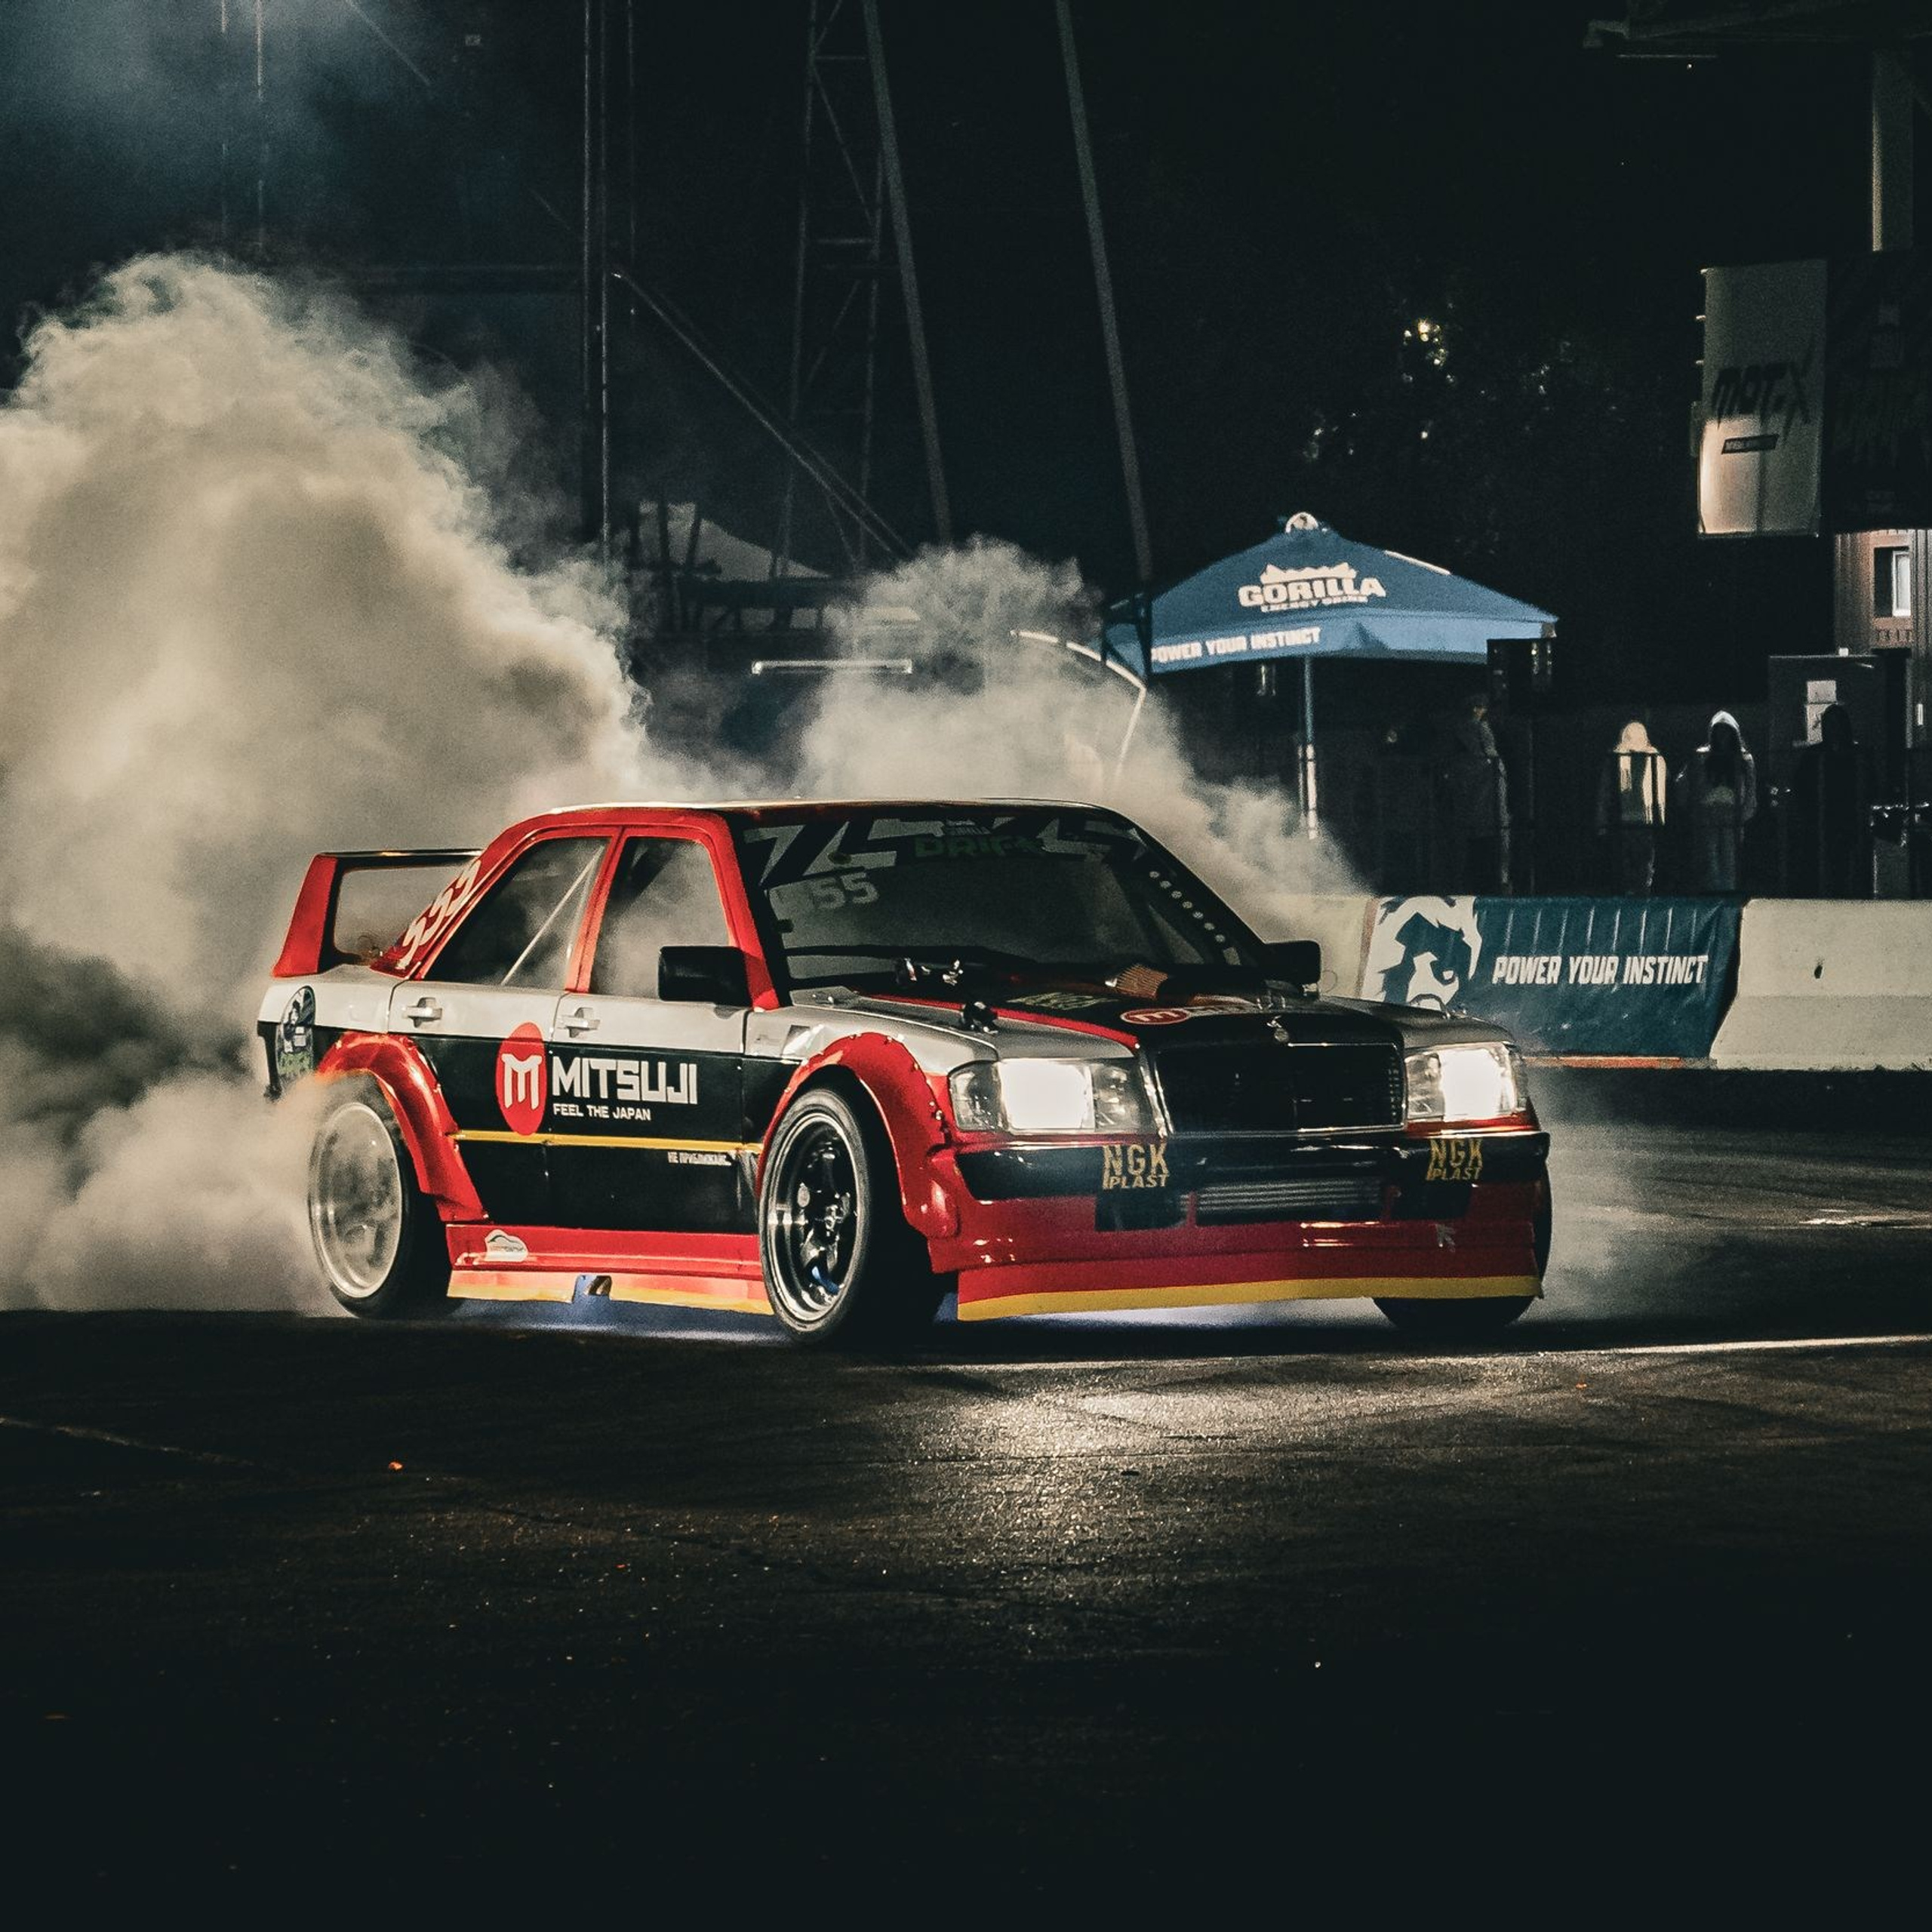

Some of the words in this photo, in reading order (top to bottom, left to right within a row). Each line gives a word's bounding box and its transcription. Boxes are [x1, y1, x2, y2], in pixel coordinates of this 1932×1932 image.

[1238, 577, 1386, 607] GORILLA
[1204, 635, 1247, 656] YOUR
[1250, 626, 1321, 650] INSTINCT
[1491, 955, 1561, 986] POWER
[1567, 955, 1620, 985] YOUR
[1623, 954, 1709, 985] INSTINCT
[552, 1056, 698, 1105] MITSUJI
[553, 1103, 584, 1117] FEEL
[586, 1105, 610, 1118] THE
[613, 1106, 651, 1121] JAPAN
[1103, 1143, 1169, 1183] NGK
[1427, 1138, 1484, 1176] NGK
[1109, 1174, 1171, 1189] PLAST
[1432, 1166, 1483, 1181] PLAST
